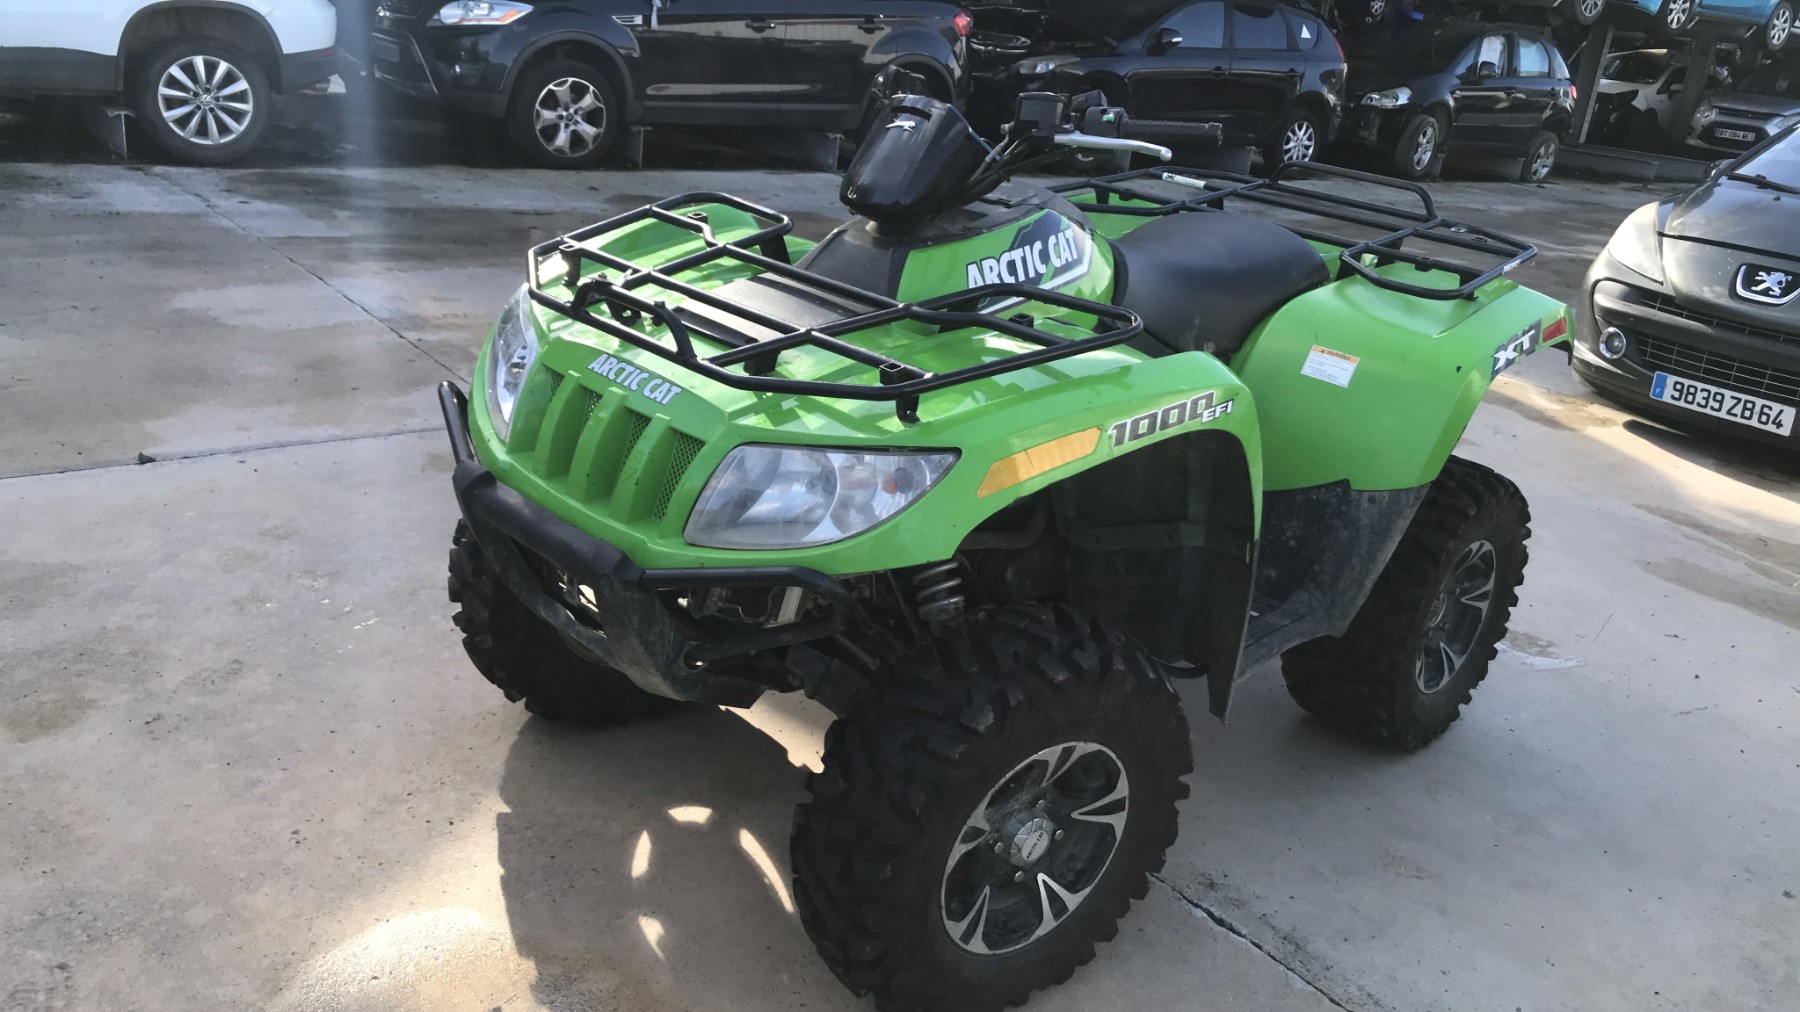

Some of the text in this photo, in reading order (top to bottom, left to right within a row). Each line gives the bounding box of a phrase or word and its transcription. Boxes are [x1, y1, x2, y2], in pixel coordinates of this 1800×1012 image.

[966, 228, 1079, 289] ARCTIC CAT
[1493, 328, 1536, 371] XT
[587, 353, 682, 405] ARCTIC CAT
[1670, 380, 1726, 413] 9839
[1107, 390, 1234, 447] 1000 EFI
